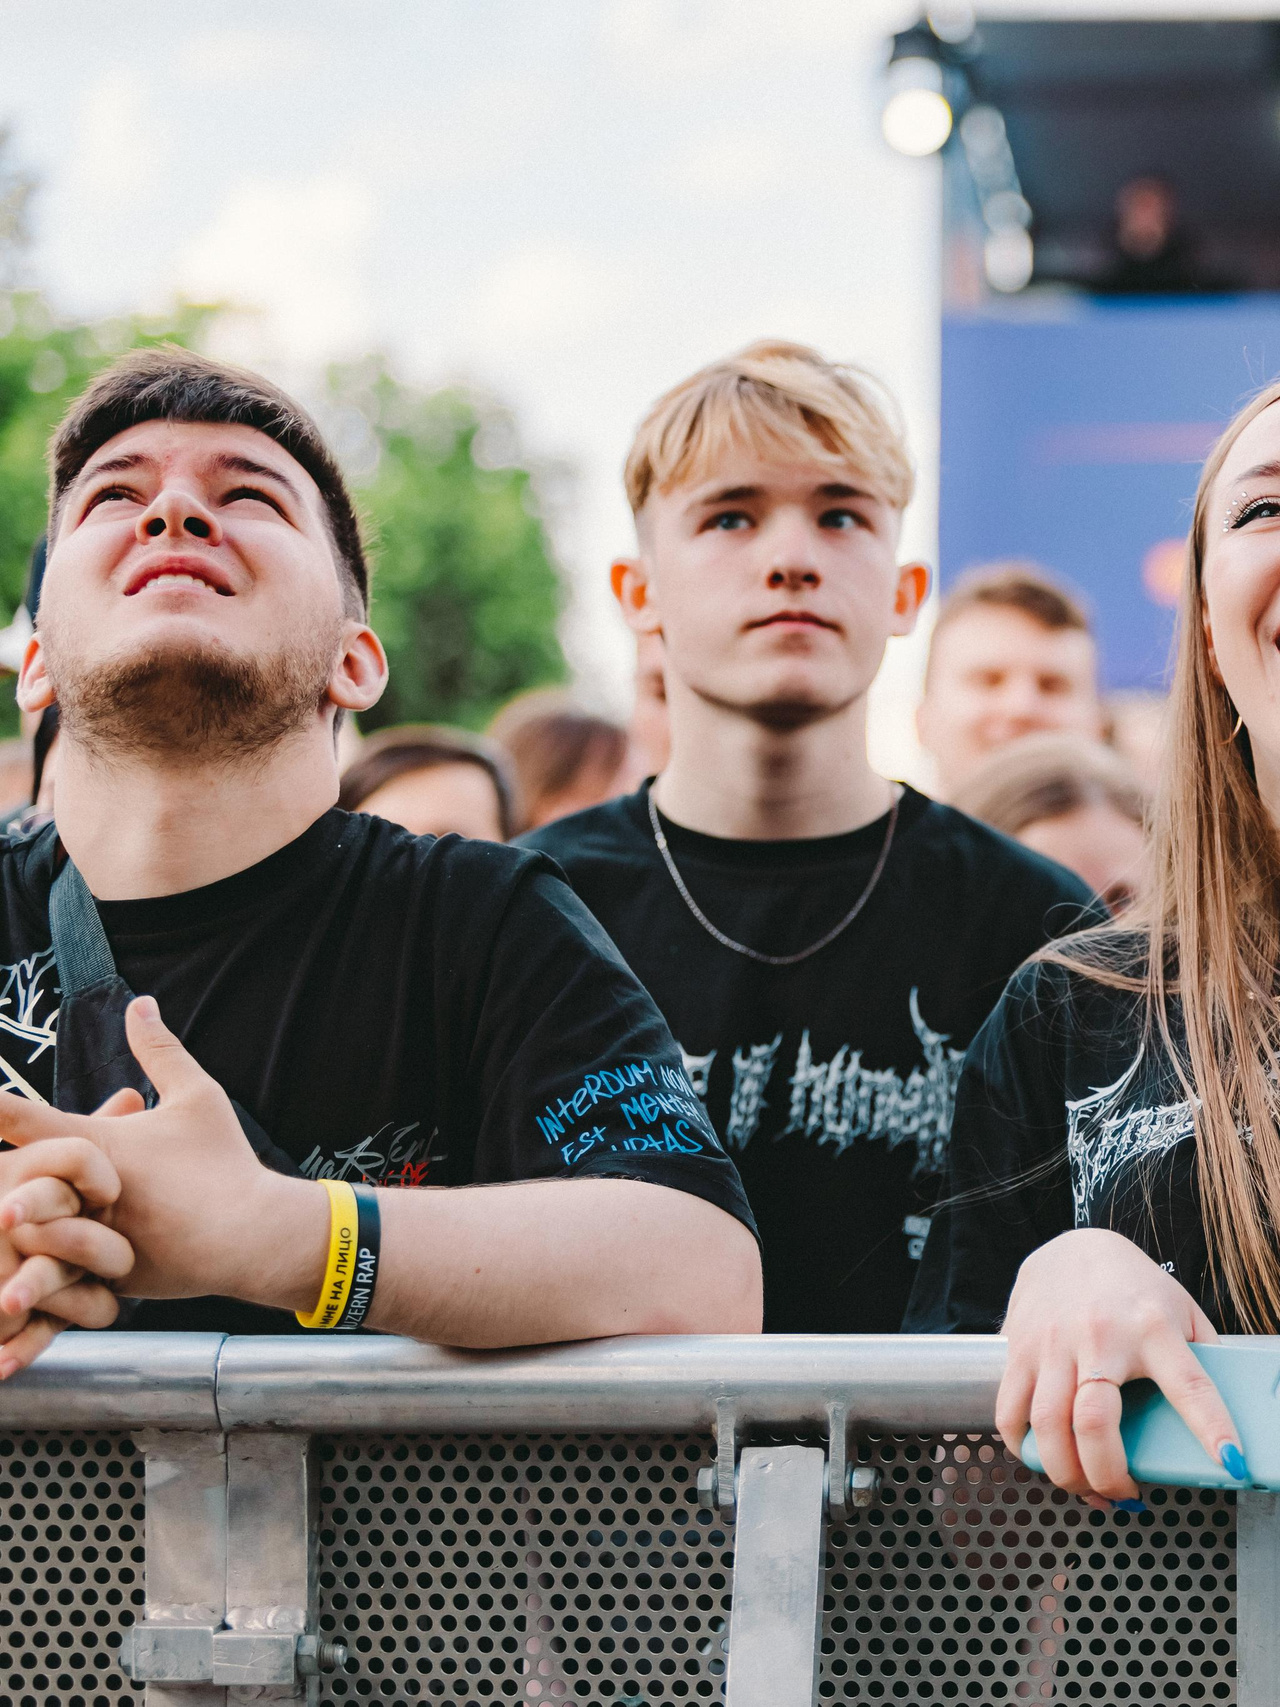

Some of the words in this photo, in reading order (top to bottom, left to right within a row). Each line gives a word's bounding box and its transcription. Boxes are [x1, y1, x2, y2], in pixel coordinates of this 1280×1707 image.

[336, 1227, 353, 1275] ЛИЦО
[356, 1247, 376, 1283] RAP
[330, 1279, 344, 1300] НА
